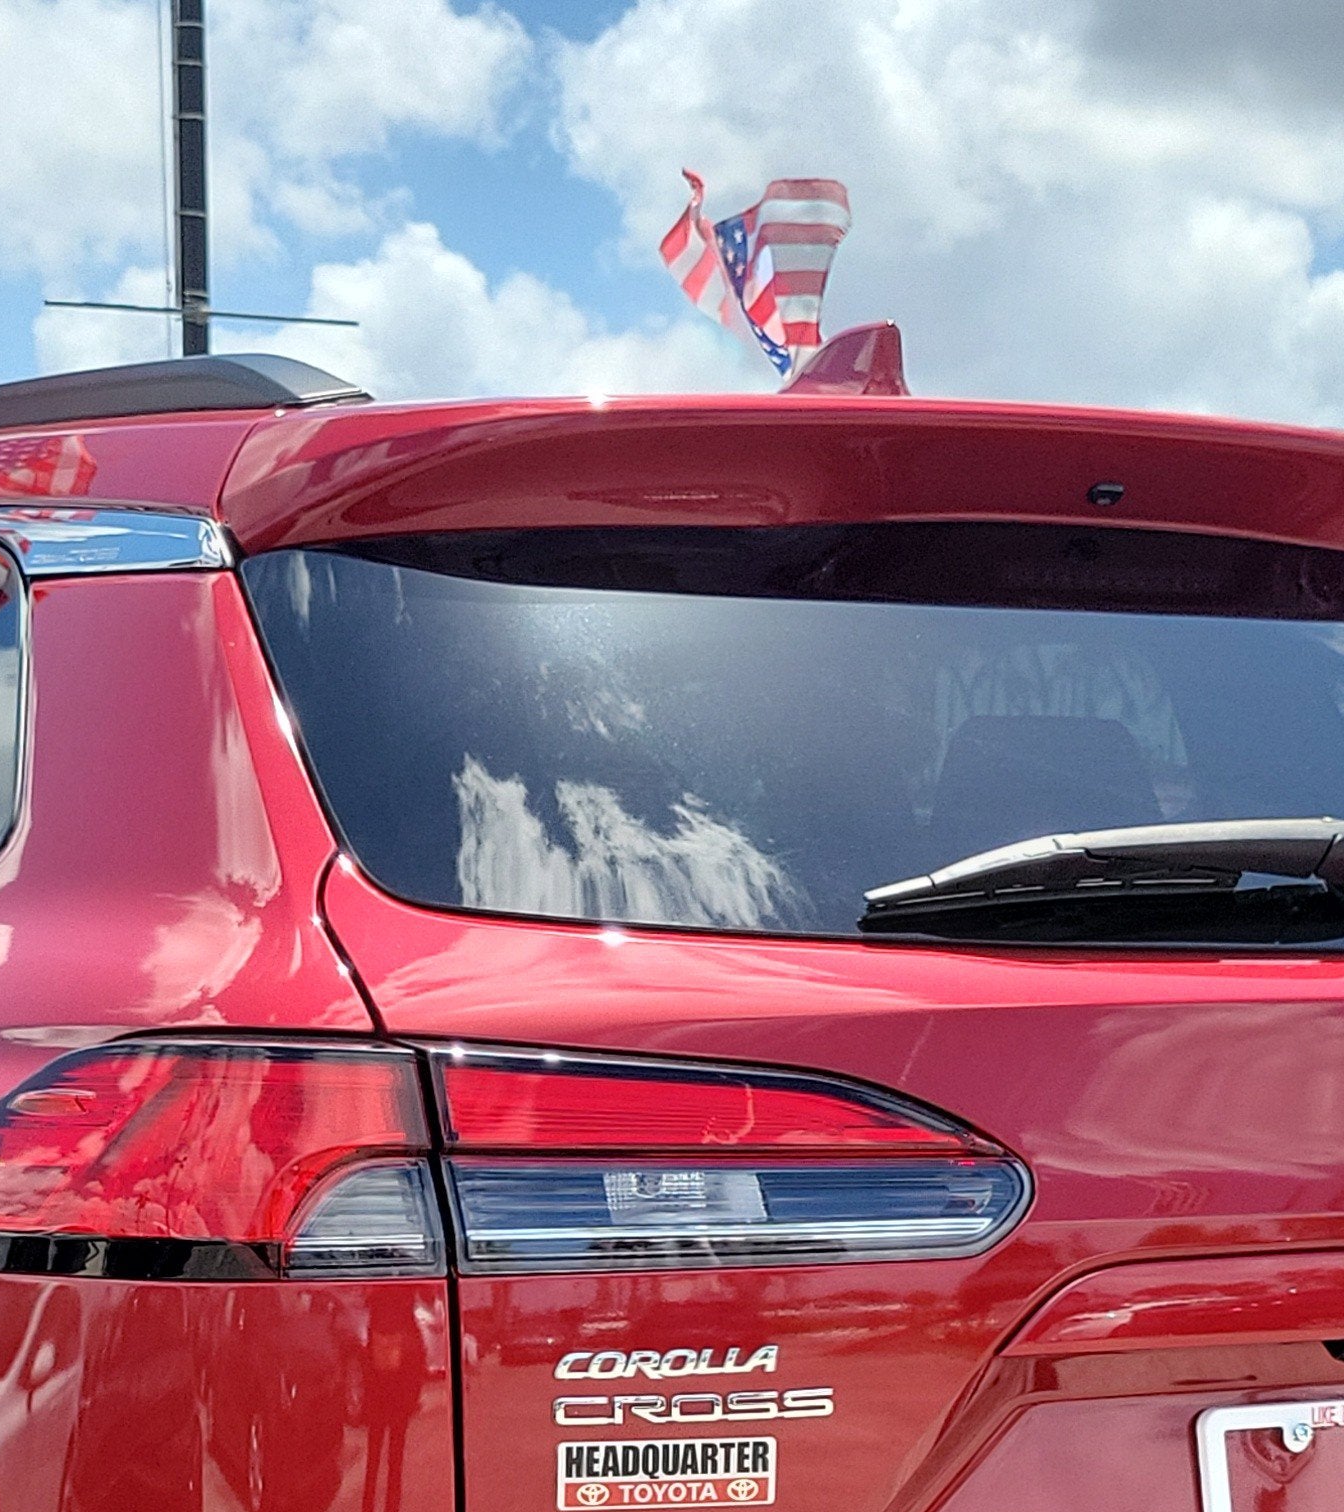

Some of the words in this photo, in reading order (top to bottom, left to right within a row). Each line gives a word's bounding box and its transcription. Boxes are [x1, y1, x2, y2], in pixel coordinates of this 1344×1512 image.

[554, 1345, 779, 1379] COROLLA
[553, 1387, 834, 1426] CROSS
[1311, 1405, 1336, 1425] LIKE
[564, 1440, 770, 1479] HEADQUARTER
[618, 1481, 718, 1504] TOYOTA
